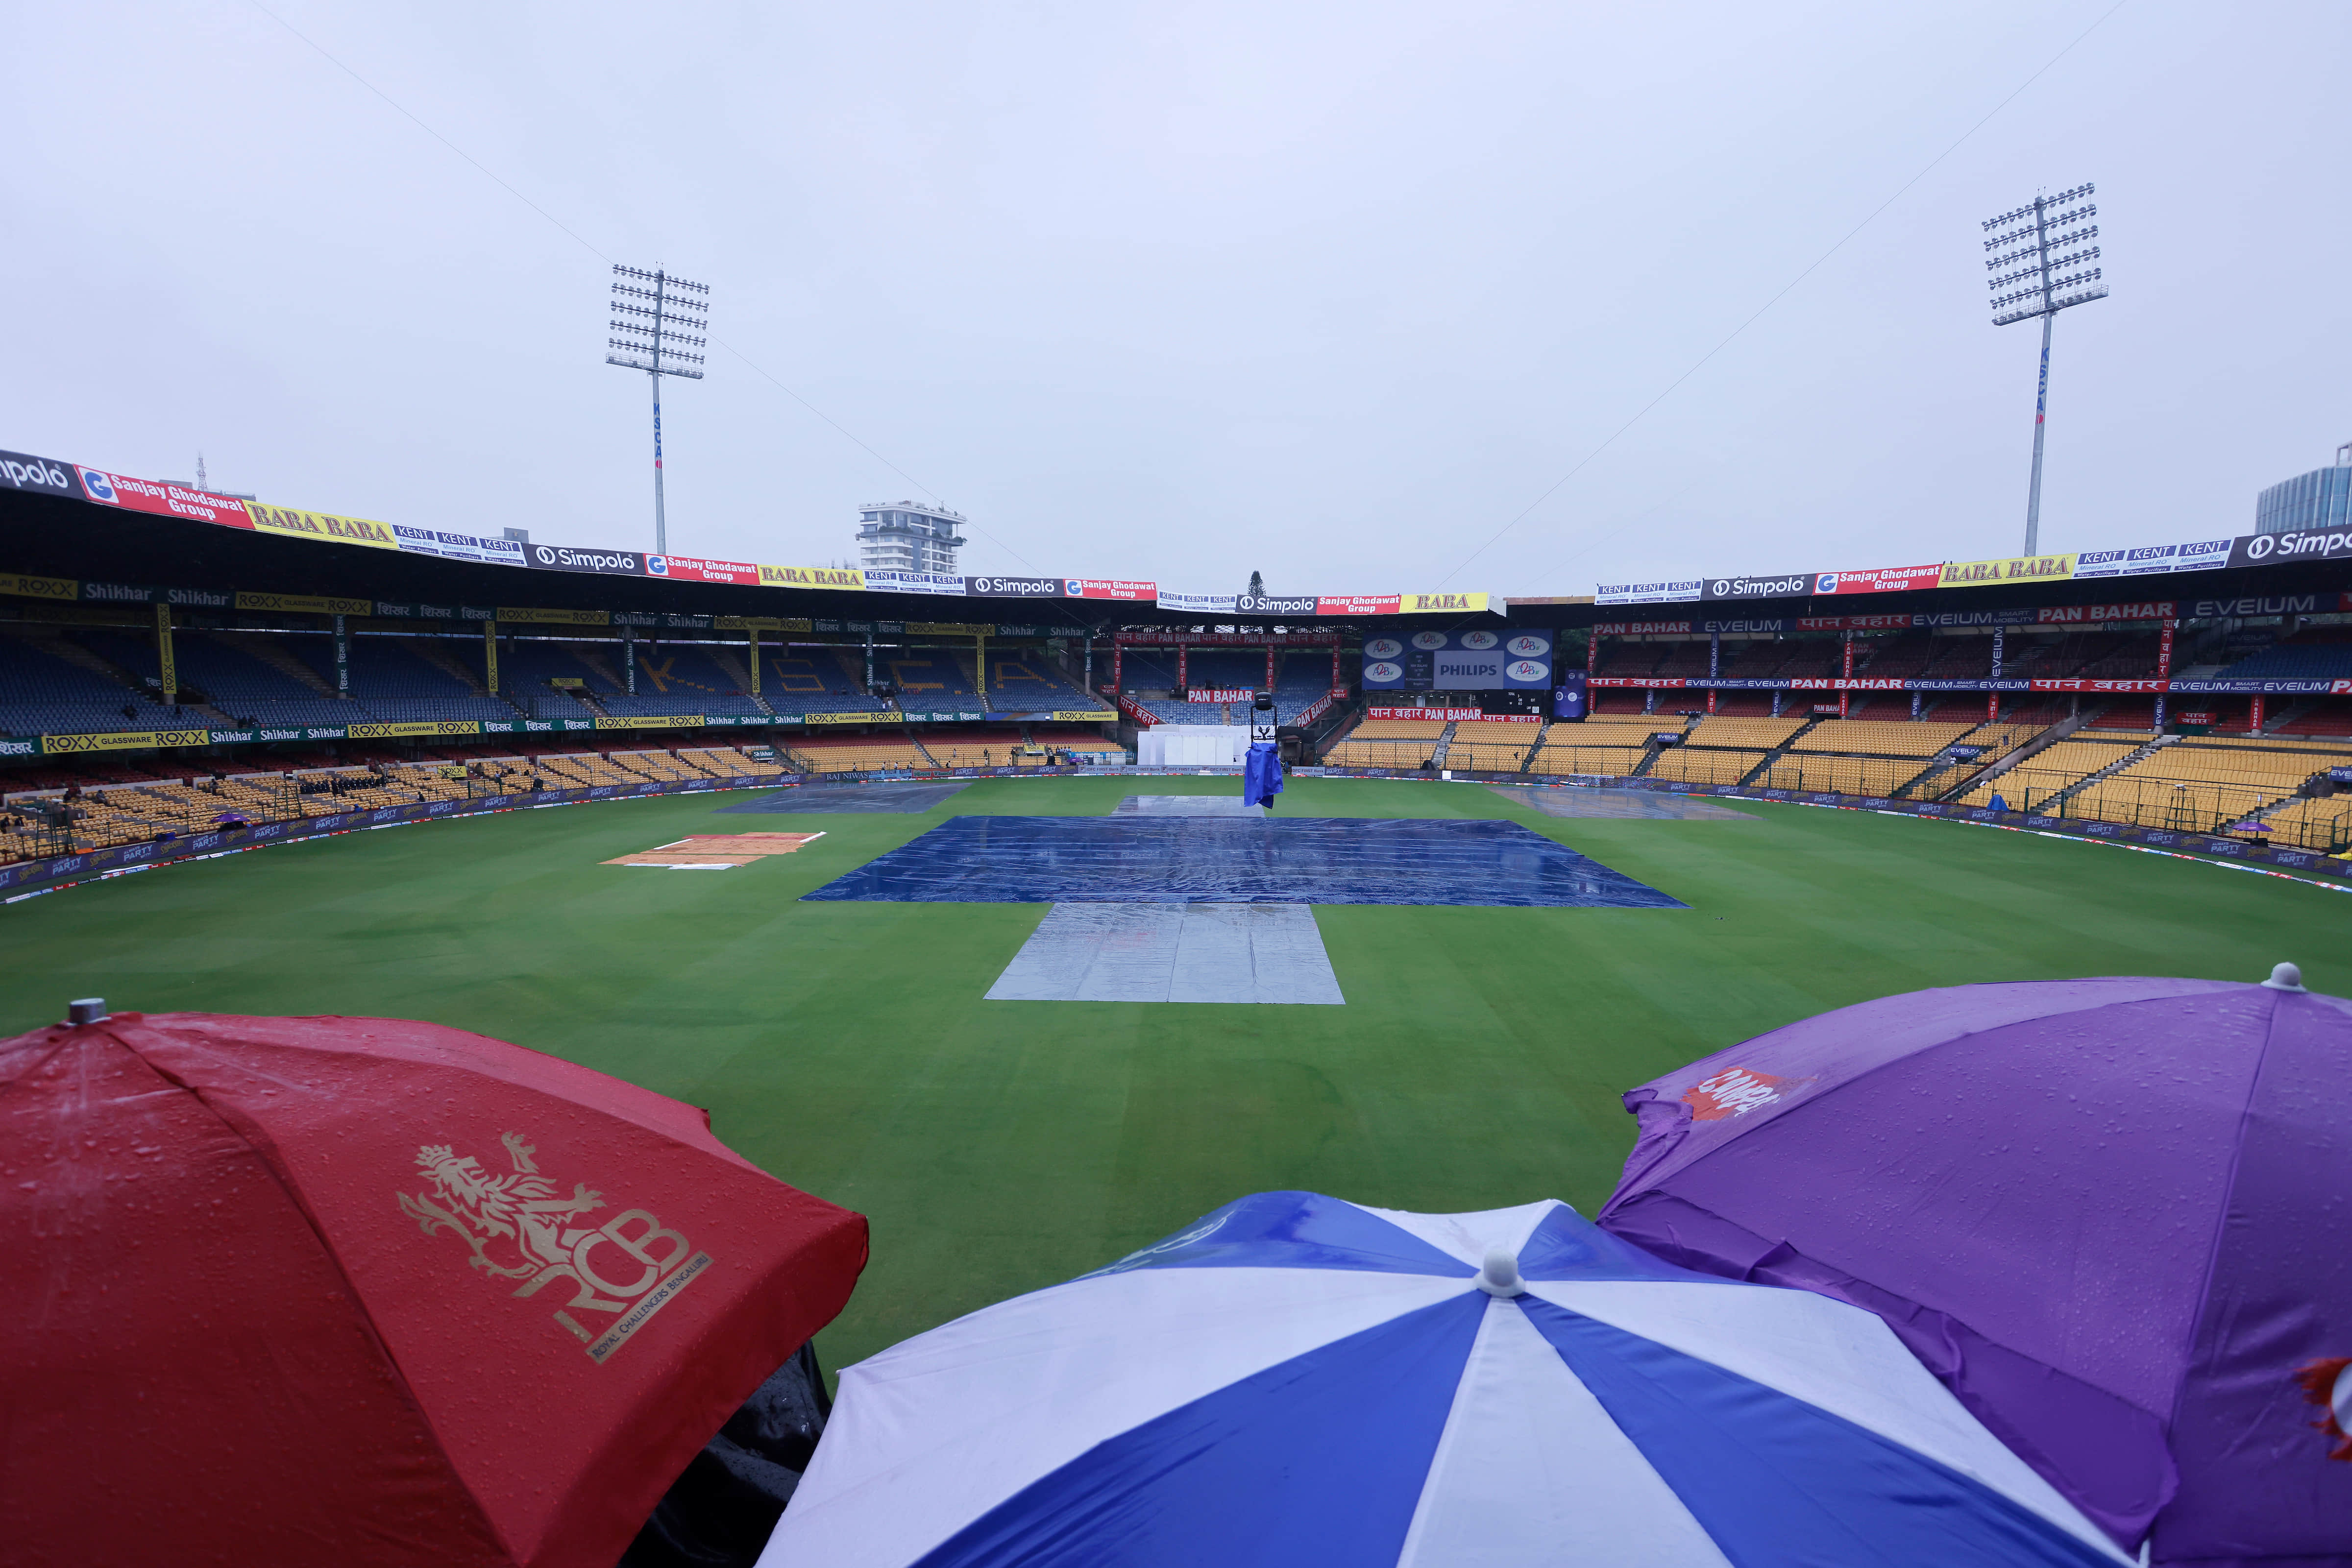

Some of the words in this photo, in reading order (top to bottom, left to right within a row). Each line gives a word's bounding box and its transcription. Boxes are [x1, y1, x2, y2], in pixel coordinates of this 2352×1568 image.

[2037, 347, 2050, 410] KSCA
[653, 403, 662, 457] KSCA
[111, 475, 167, 500] Sanjay
[168, 486, 245, 512] Ghodawat
[169, 499, 216, 520] Group
[248, 504, 324, 534] BABA
[321, 516, 393, 543] BABA
[398, 526, 429, 539] KENT
[400, 537, 422, 547] Mineral
[441, 533, 471, 546] KENT
[484, 539, 514, 552] KENT
[2133, 546, 2170, 559] KENT
[2184, 541, 2224, 555] KENT
[558, 549, 635, 571] Simpolo
[2084, 551, 2119, 563] KENT
[667, 557, 703, 570] Sanjay
[705, 560, 756, 573] Ghodawat
[1942, 563, 2002, 582] BABA
[2006, 557, 2069, 579] BABA
[703, 571, 734, 582] Group
[760, 567, 811, 583] BABA
[812, 570, 862, 586] BABA
[869, 572, 892, 580] KENT
[903, 574, 926, 582] KENT
[1839, 572, 1878, 583] Sanjay
[1881, 565, 1940, 579] Ghodawat
[18, 579, 73, 597] ROXX
[993, 579, 1054, 595] Simpolo
[1082, 580, 1111, 590] Sanjay
[1113, 581, 1155, 590] Ghodawat
[1602, 585, 1626, 594] KENT
[1637, 583, 1662, 592] KENT
[1671, 581, 1696, 590] KENT
[1732, 579, 1804, 596] Simpolo
[1874, 579, 1909, 590] Group
[85, 583, 153, 600] Shikhar
[168, 589, 229, 605] Shikhar
[1110, 589, 1136, 598] Group
[239, 594, 283, 608] ROXX
[328, 599, 368, 613] ROXX
[1257, 597, 1314, 613] Simpolo
[1319, 597, 1351, 606] Sanjay
[1352, 596, 1400, 604] Ghodawat
[1415, 594, 1470, 609] BABA
[2195, 595, 2315, 616] EVEIUM
[377, 602, 411, 616] शिखर
[420, 604, 451, 617] शिखर
[461, 606, 492, 619] शिखर
[1348, 604, 1375, 613] Group
[2039, 607, 2082, 621] PAN
[2090, 602, 2173, 619] BAHAR
[498, 610, 534, 620] ROXX
[572, 612, 607, 623] ROXX
[614, 614, 658, 626] Shikhar
[667, 617, 710, 627] Shikhar
[1799, 617, 1843, 627] पान
[1848, 614, 1910, 627] बहार
[1912, 612, 1992, 626] EVEIUM
[716, 618, 746, 627] ROXX
[780, 620, 809, 630] ROXX
[907, 624, 934, 633] ROXX
[965, 626, 993, 635] ROXX
[1593, 624, 1626, 634] PAN
[1631, 622, 1690, 633] BAHAR
[1705, 620, 1782, 632] EVEIUM
[1001, 626, 1036, 636] Shikhar
[1050, 627, 1086, 636] Shikhar
[1158, 634, 1173, 642] PAN
[1176, 634, 1200, 643] BAHAR
[1244, 634, 1259, 643] PAN
[1261, 634, 1286, 643] BAHAR
[1440, 664, 1497, 676] PHILIPS
[1631, 678, 1683, 687] बहार
[1791, 679, 1828, 688] PAN
[1834, 679, 1902, 689] BAHAR
[2033, 680, 2085, 689] पान
[2094, 680, 2169, 691] बहार
[2169, 682, 2230, 690] EVEIUM
[2264, 682, 2330, 691] EVEIUM
[1189, 691, 1210, 702] PAN
[1214, 690, 1253, 702] BAHAR
[1059, 712, 1085, 720] ROXX
[1297, 711, 1310, 727] PAN
[1311, 695, 1332, 721] BAHAR
[1369, 708, 1392, 718] पान
[1394, 708, 1423, 719] बहार
[1425, 709, 1444, 720] PAN
[1447, 709, 1481, 720] BAHAR
[598, 718, 632, 728] ROXX
[669, 716, 701, 727] ROXX
[707, 717, 736, 725] Shikhar
[741, 716, 770, 724] Shikhar
[775, 716, 804, 724] Shikhar
[808, 714, 837, 723] ROXX
[871, 713, 900, 722] ROXX
[351, 725, 392, 737] ROXX
[438, 722, 477, 734] ROXX
[484, 721, 513, 732] शिखर
[525, 720, 552, 731] शिखर
[564, 720, 590, 730] शिखर
[211, 731, 253, 743] Shikhar
[260, 729, 300, 741] Shikhar
[307, 727, 345, 739] Shikhar
[46, 735, 99, 752] ROXX
[101, 736, 152, 745] GLASSWARE
[156, 731, 205, 746] ROXX
[842, 771, 868, 780] NIWAS
[316, 816, 341, 830] PARTY
[255, 824, 280, 839] PARTY
[193, 834, 219, 850] PARTY
[123, 844, 153, 862] PARTY
[591, 1334, 620, 1358] ROYAL
[619, 1289, 669, 1333] CHALLENGERS
[666, 1255, 709, 1290] BENGALURU
